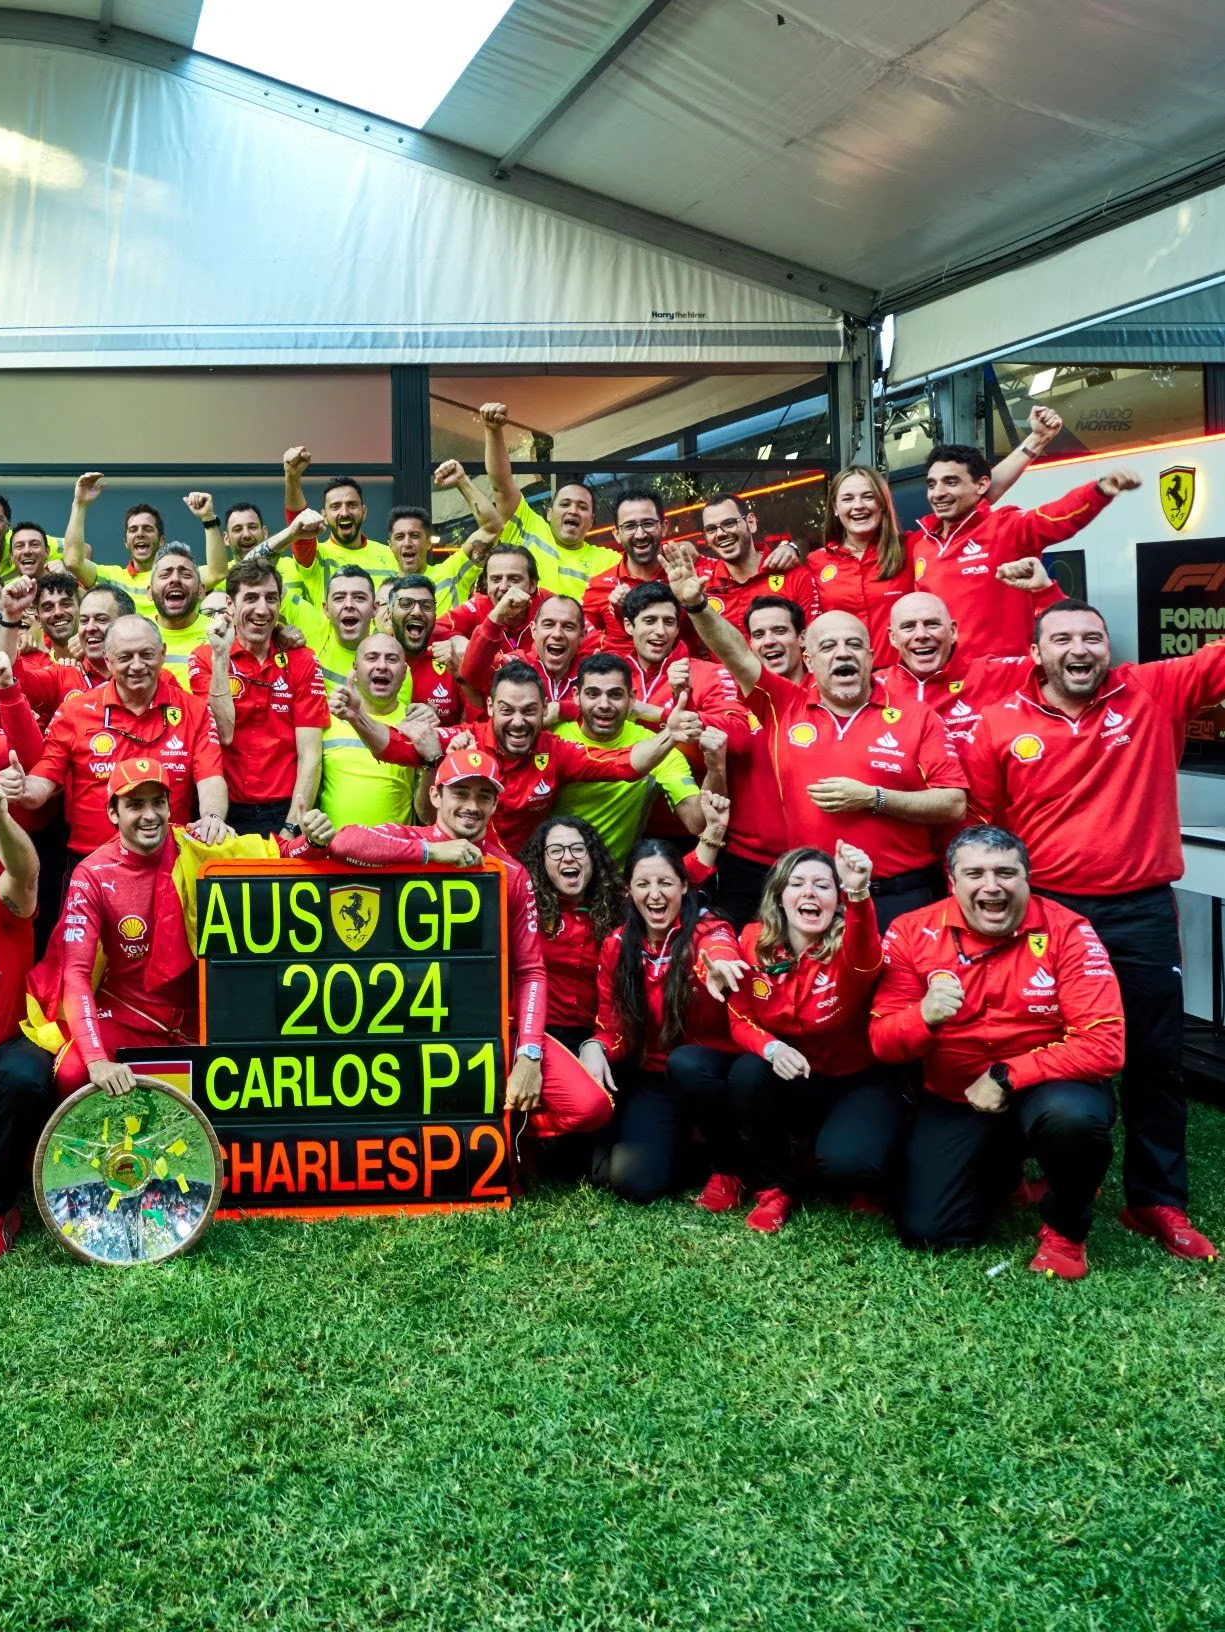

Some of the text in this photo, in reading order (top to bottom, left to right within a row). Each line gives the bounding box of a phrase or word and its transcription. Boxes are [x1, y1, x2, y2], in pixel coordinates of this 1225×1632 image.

[651, 311, 674, 320] Harry
[1079, 408, 1133, 419] LANDO
[1075, 420, 1133, 431] NORRIS
[1160, 633, 1225, 655] ROL
[945, 714, 983, 725] Santander
[868, 746, 906, 757] Santander
[89, 763, 116, 772] VGW
[871, 760, 901, 771] CEVA
[198, 881, 323, 955] AUS
[397, 879, 481, 951] GP
[120, 943, 149, 954] VGW
[280, 961, 449, 1035] 2024
[205, 1043, 496, 1115] CARLOS P1
[422, 1125, 508, 1197] P2
